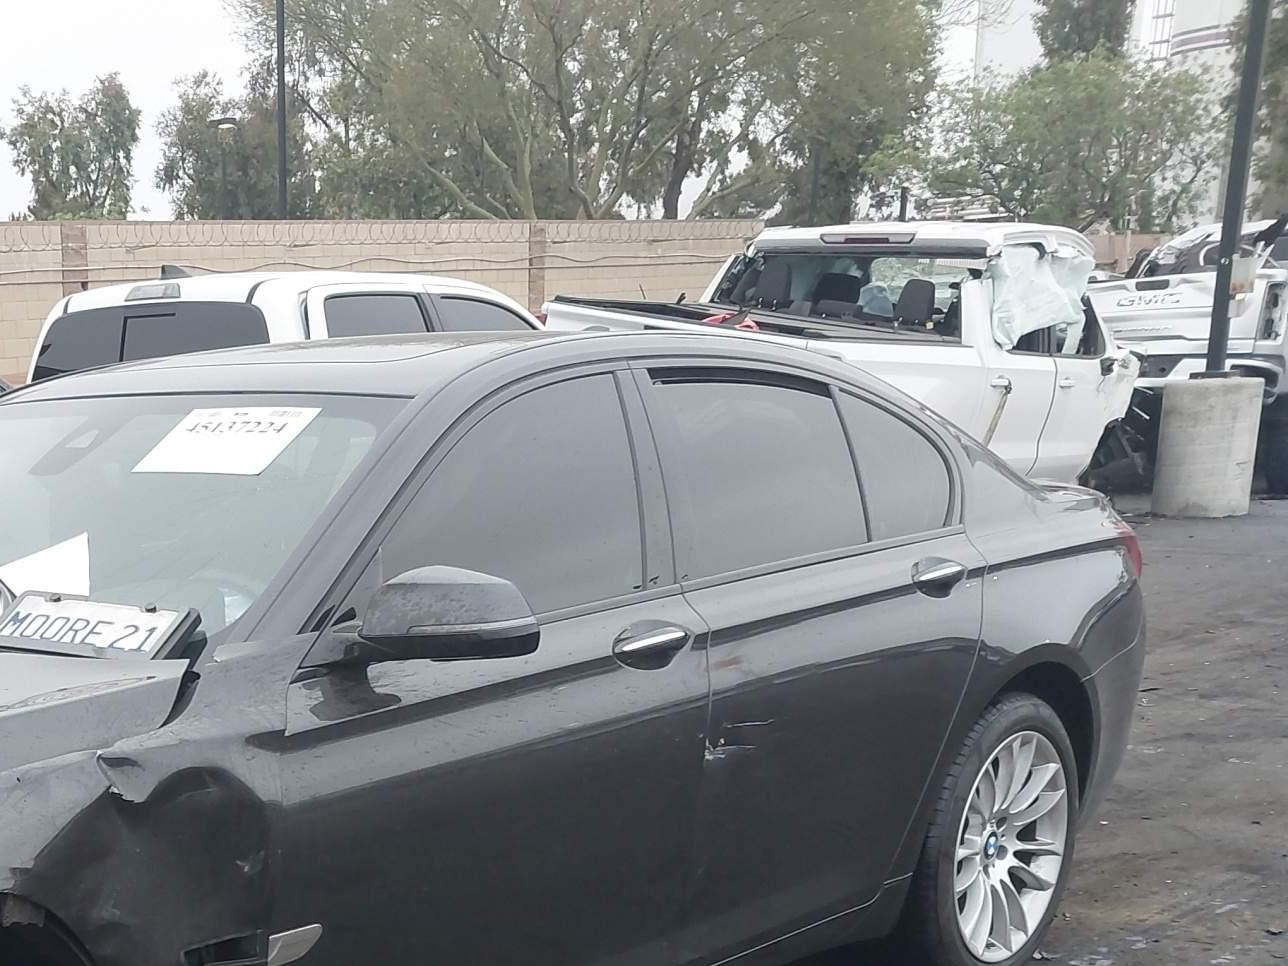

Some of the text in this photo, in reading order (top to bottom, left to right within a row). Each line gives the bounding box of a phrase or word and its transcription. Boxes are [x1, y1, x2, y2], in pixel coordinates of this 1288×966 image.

[1116, 292, 1183, 307] GMC
[186, 420, 289, 434] 45137224
[108, 624, 158, 653] 21
